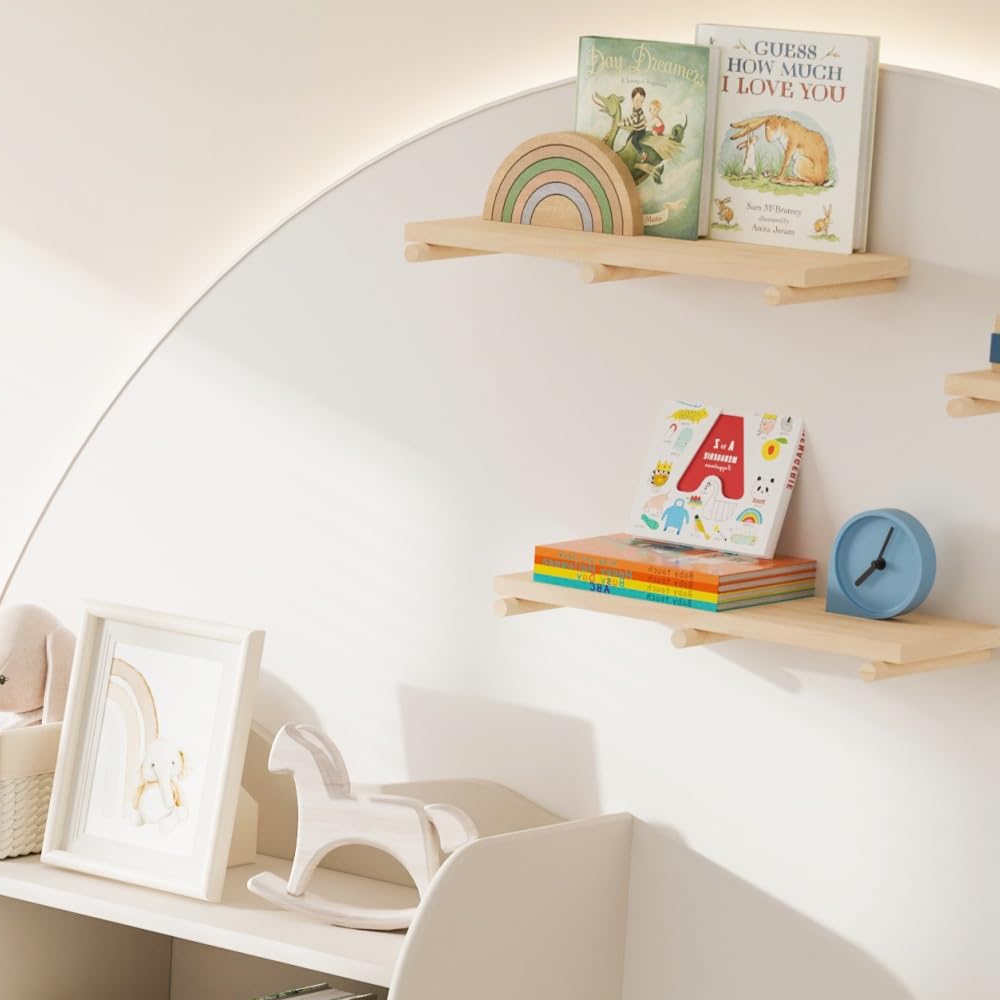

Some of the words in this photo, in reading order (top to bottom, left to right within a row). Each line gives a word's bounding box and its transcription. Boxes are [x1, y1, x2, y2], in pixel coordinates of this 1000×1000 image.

[754, 40, 817, 60] GUESS
[586, 45, 622, 78] Day
[631, 42, 705, 88] Dreamers
[728, 57, 775, 75] HOW
[781, 61, 844, 81] MUCH
[721, 75, 729, 92] I
[736, 77, 794, 99] LOVE
[799, 82, 847, 103] YOU
